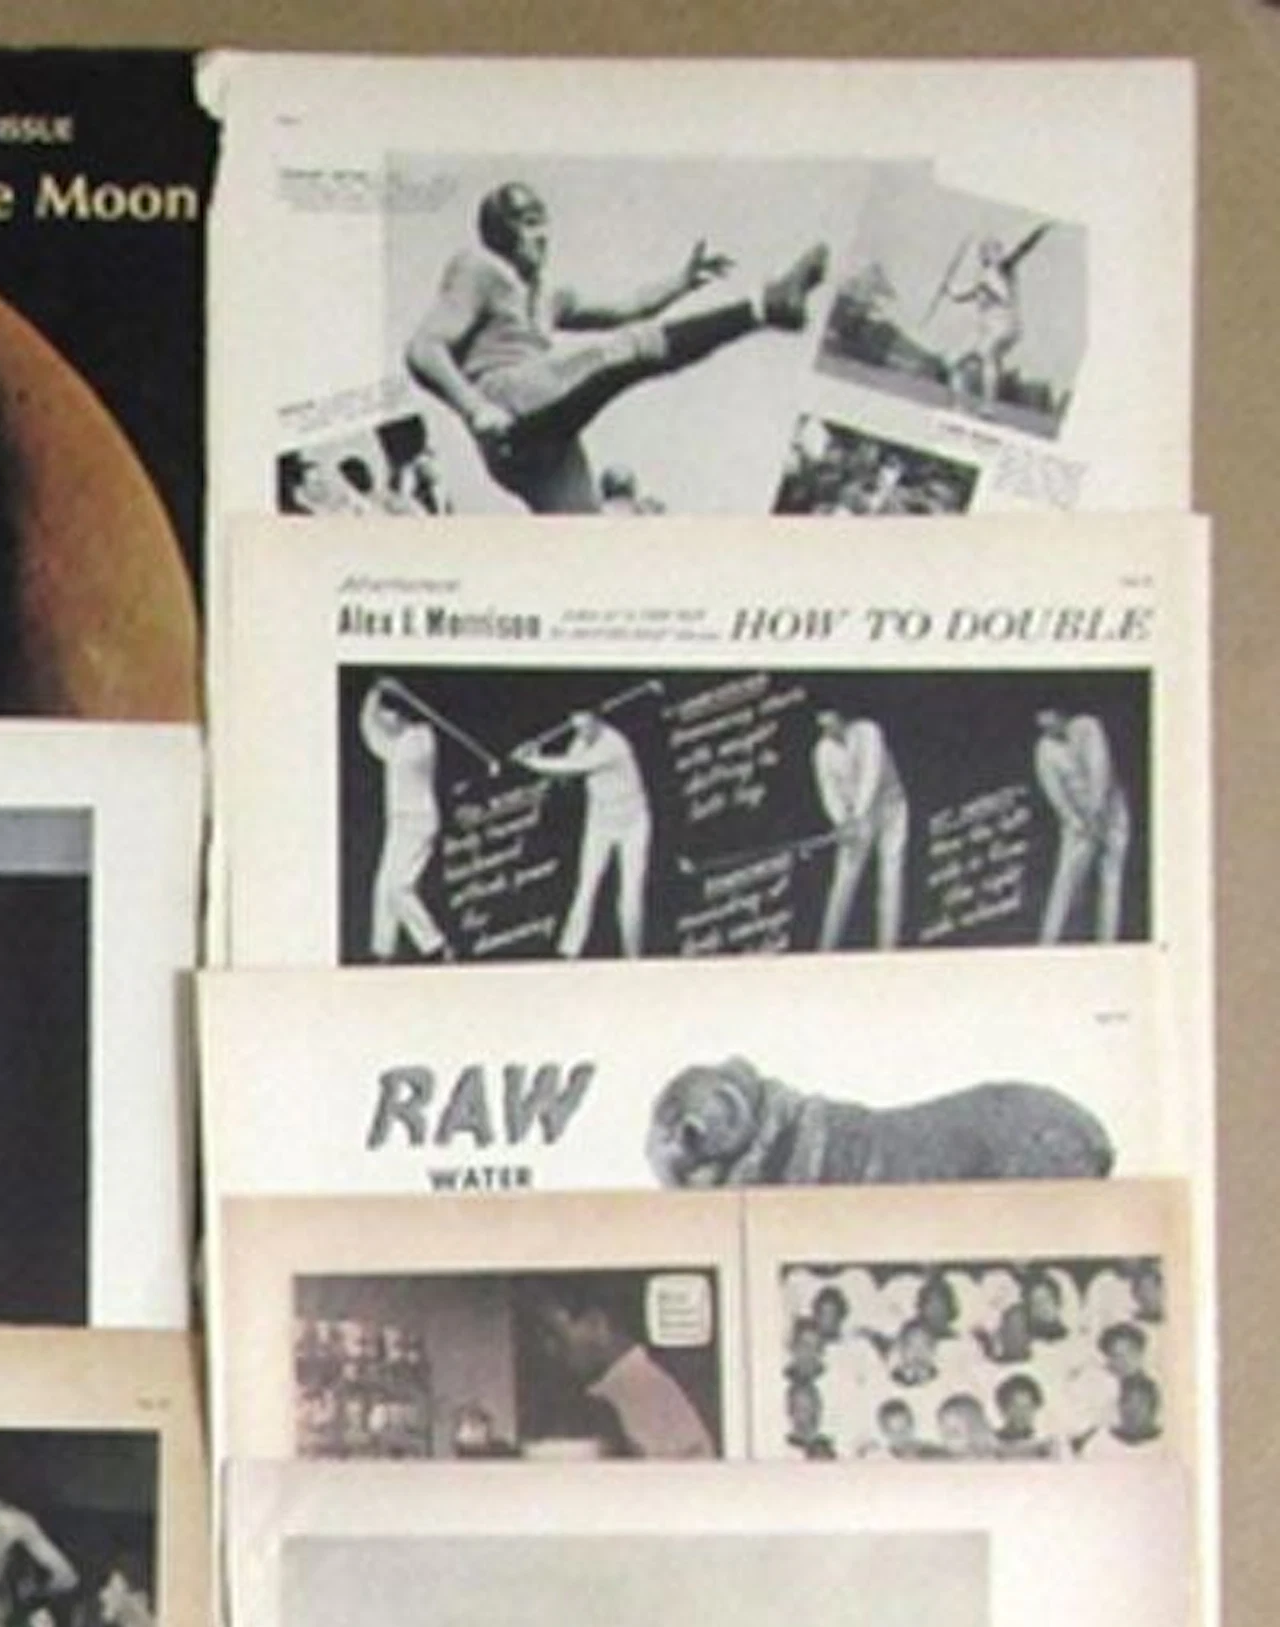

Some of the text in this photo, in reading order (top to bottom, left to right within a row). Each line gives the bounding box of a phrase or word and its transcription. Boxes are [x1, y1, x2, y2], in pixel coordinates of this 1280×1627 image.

[37, 174, 198, 219] Moon
[337, 605, 393, 638] Alex
[426, 605, 541, 639] Morrison
[730, 607, 847, 641] HOW
[865, 607, 931, 641] TO
[945, 607, 1154, 641] DOUBLE
[365, 1060, 597, 1153] RAW
[427, 1165, 534, 1190] WATER
